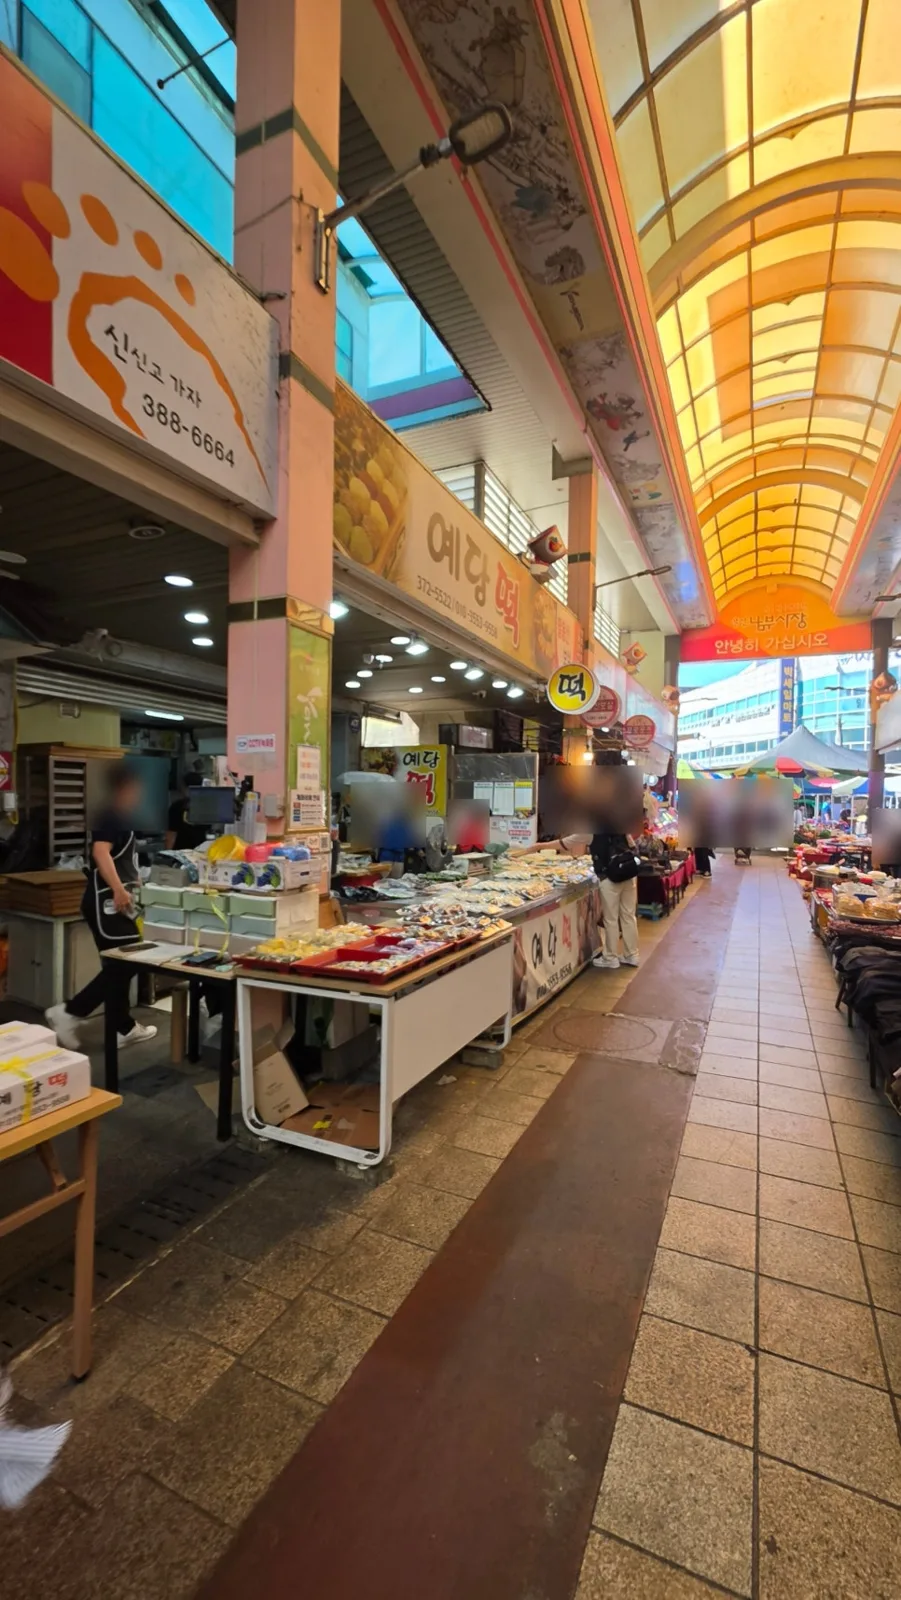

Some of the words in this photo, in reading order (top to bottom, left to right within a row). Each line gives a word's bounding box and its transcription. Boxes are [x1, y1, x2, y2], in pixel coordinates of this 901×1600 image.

[104, 324, 165, 384] 신신고
[169, 374, 202, 408] 가자
[142, 393, 235, 468] 388-6664
[714, 638, 759, 655] 안녕히
[765, 633, 829, 650] 가십시오
[557, 672, 587, 702] 떡
[402, 750, 441, 769] 예당
